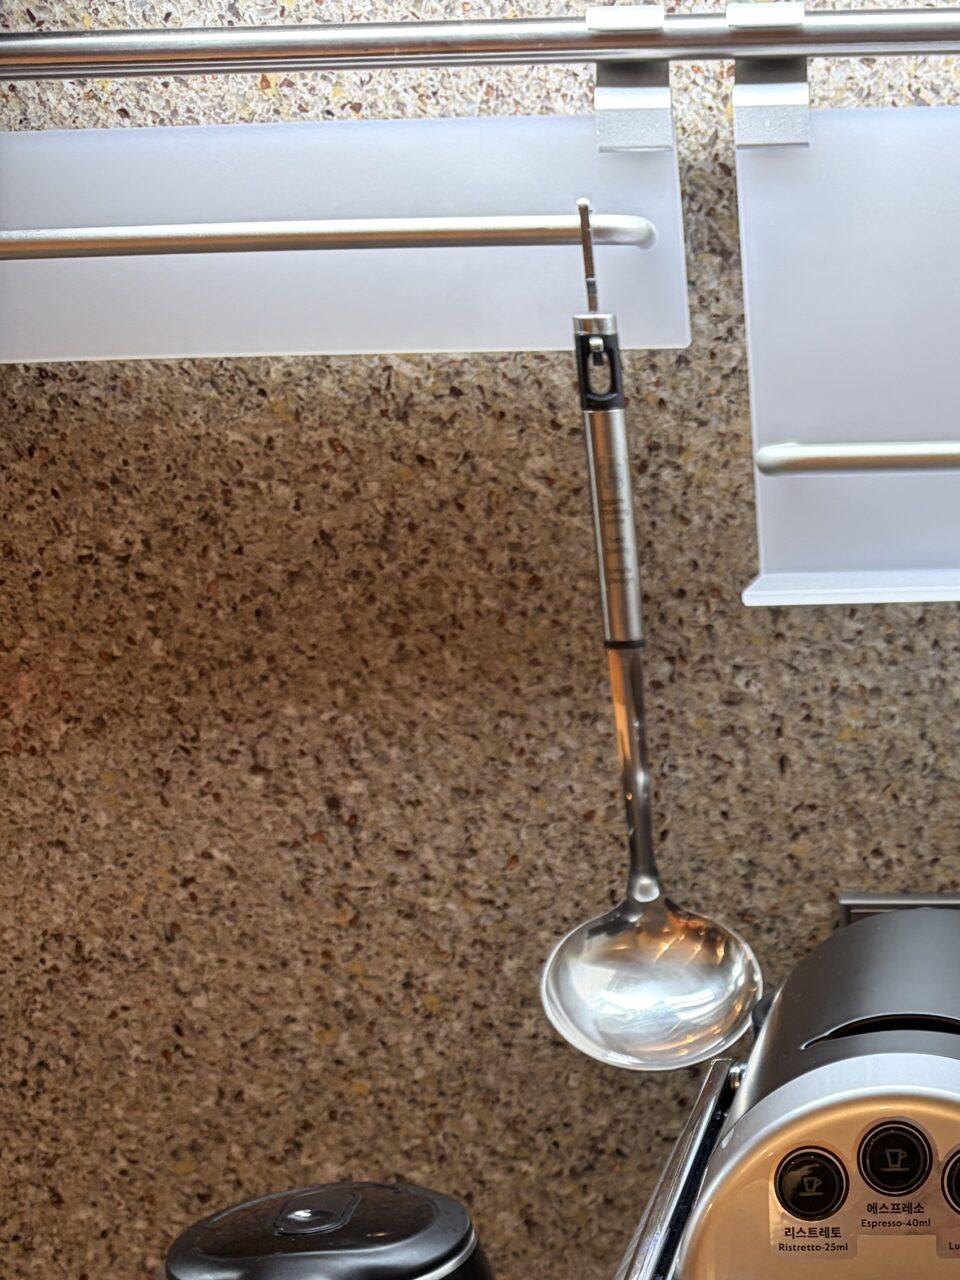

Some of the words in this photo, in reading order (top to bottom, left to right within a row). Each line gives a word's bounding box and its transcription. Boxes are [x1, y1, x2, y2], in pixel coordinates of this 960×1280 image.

[867, 1202, 925, 1215] 에스프레소
[861, 1218, 931, 1229] Espresso-40ml
[784, 1226, 842, 1239] 리스트레토
[778, 1242, 848, 1252] Ristretto-25ml
